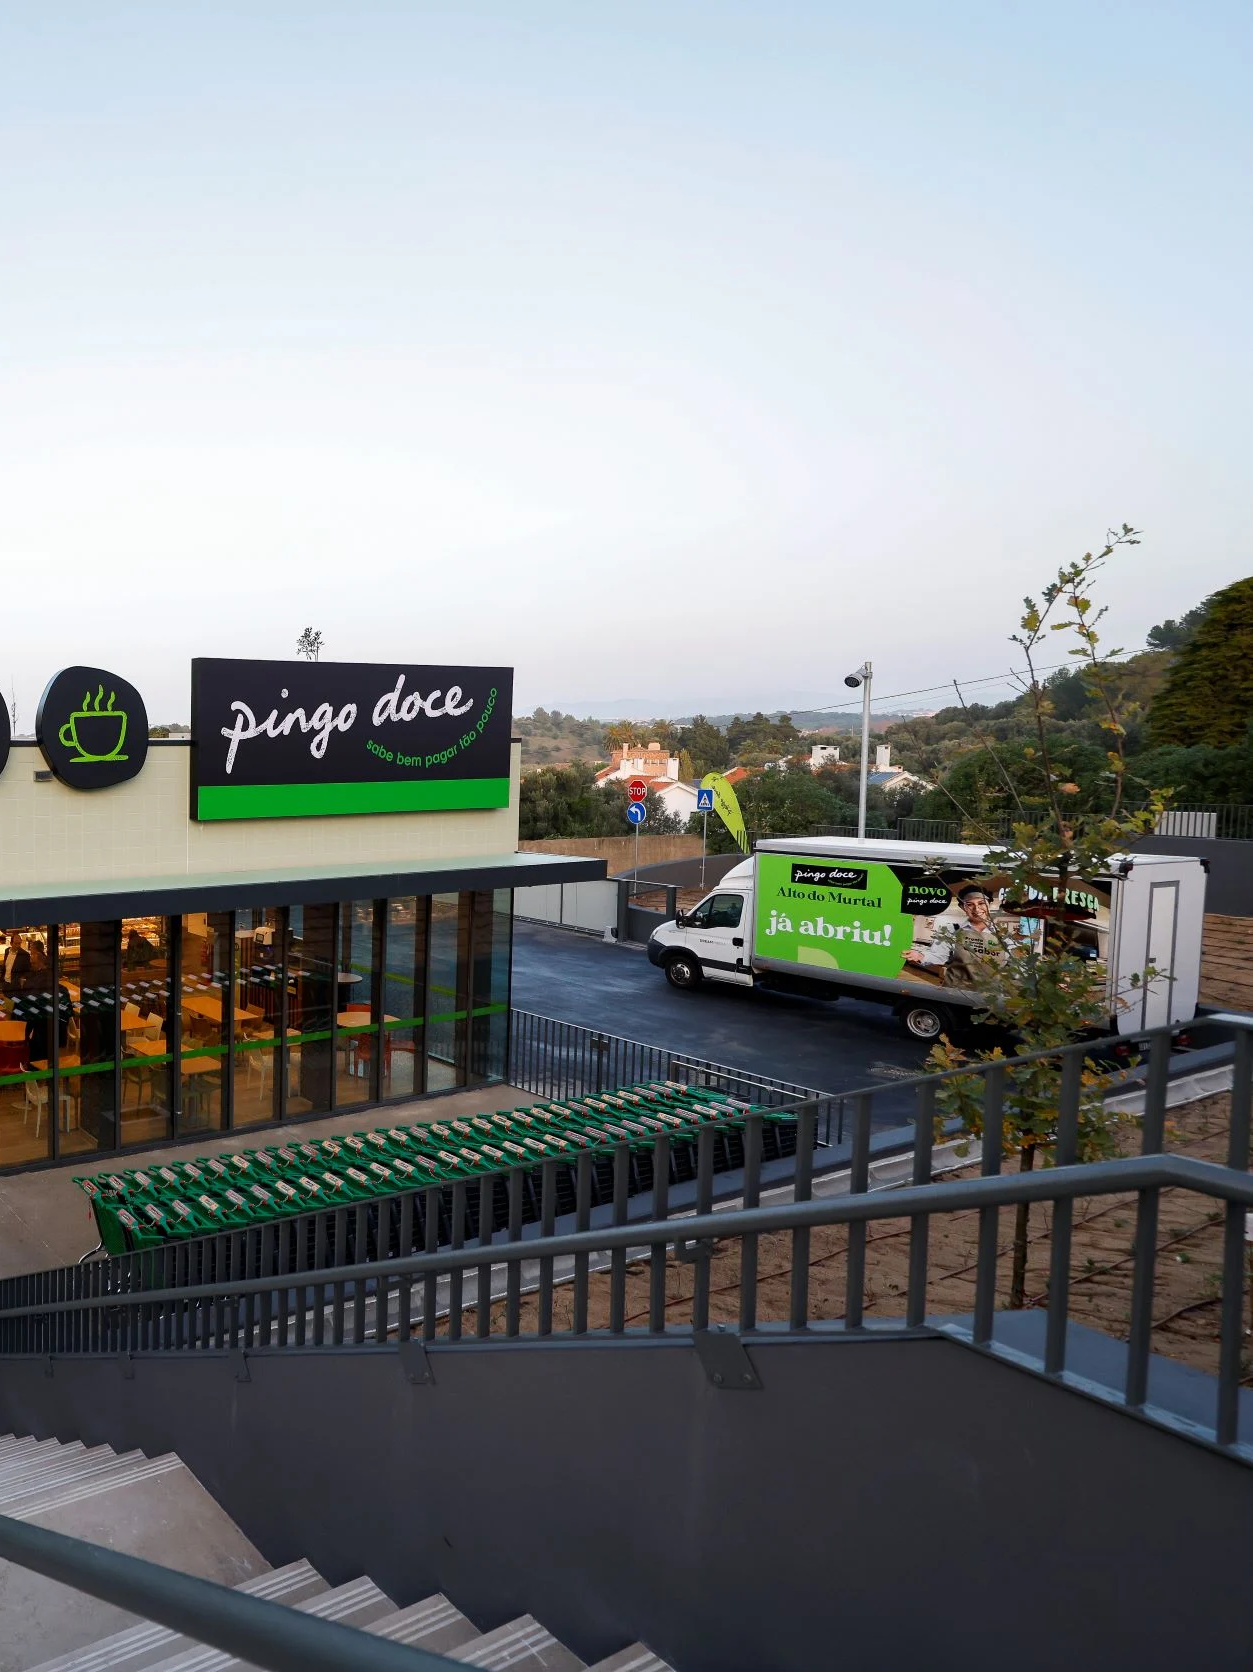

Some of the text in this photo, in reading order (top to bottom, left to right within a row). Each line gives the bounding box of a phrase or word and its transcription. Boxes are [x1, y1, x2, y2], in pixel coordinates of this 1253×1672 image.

[220, 673, 474, 774] pingo doce
[366, 687, 498, 768] sabe bem pagar tão pouco
[629, 786, 646, 796] STOP
[794, 869, 826, 882] pingo
[829, 869, 857, 879] doce
[777, 886, 883, 909] Alto do Murtal
[908, 884, 947, 897] novo
[765, 909, 893, 947] já abriu!
